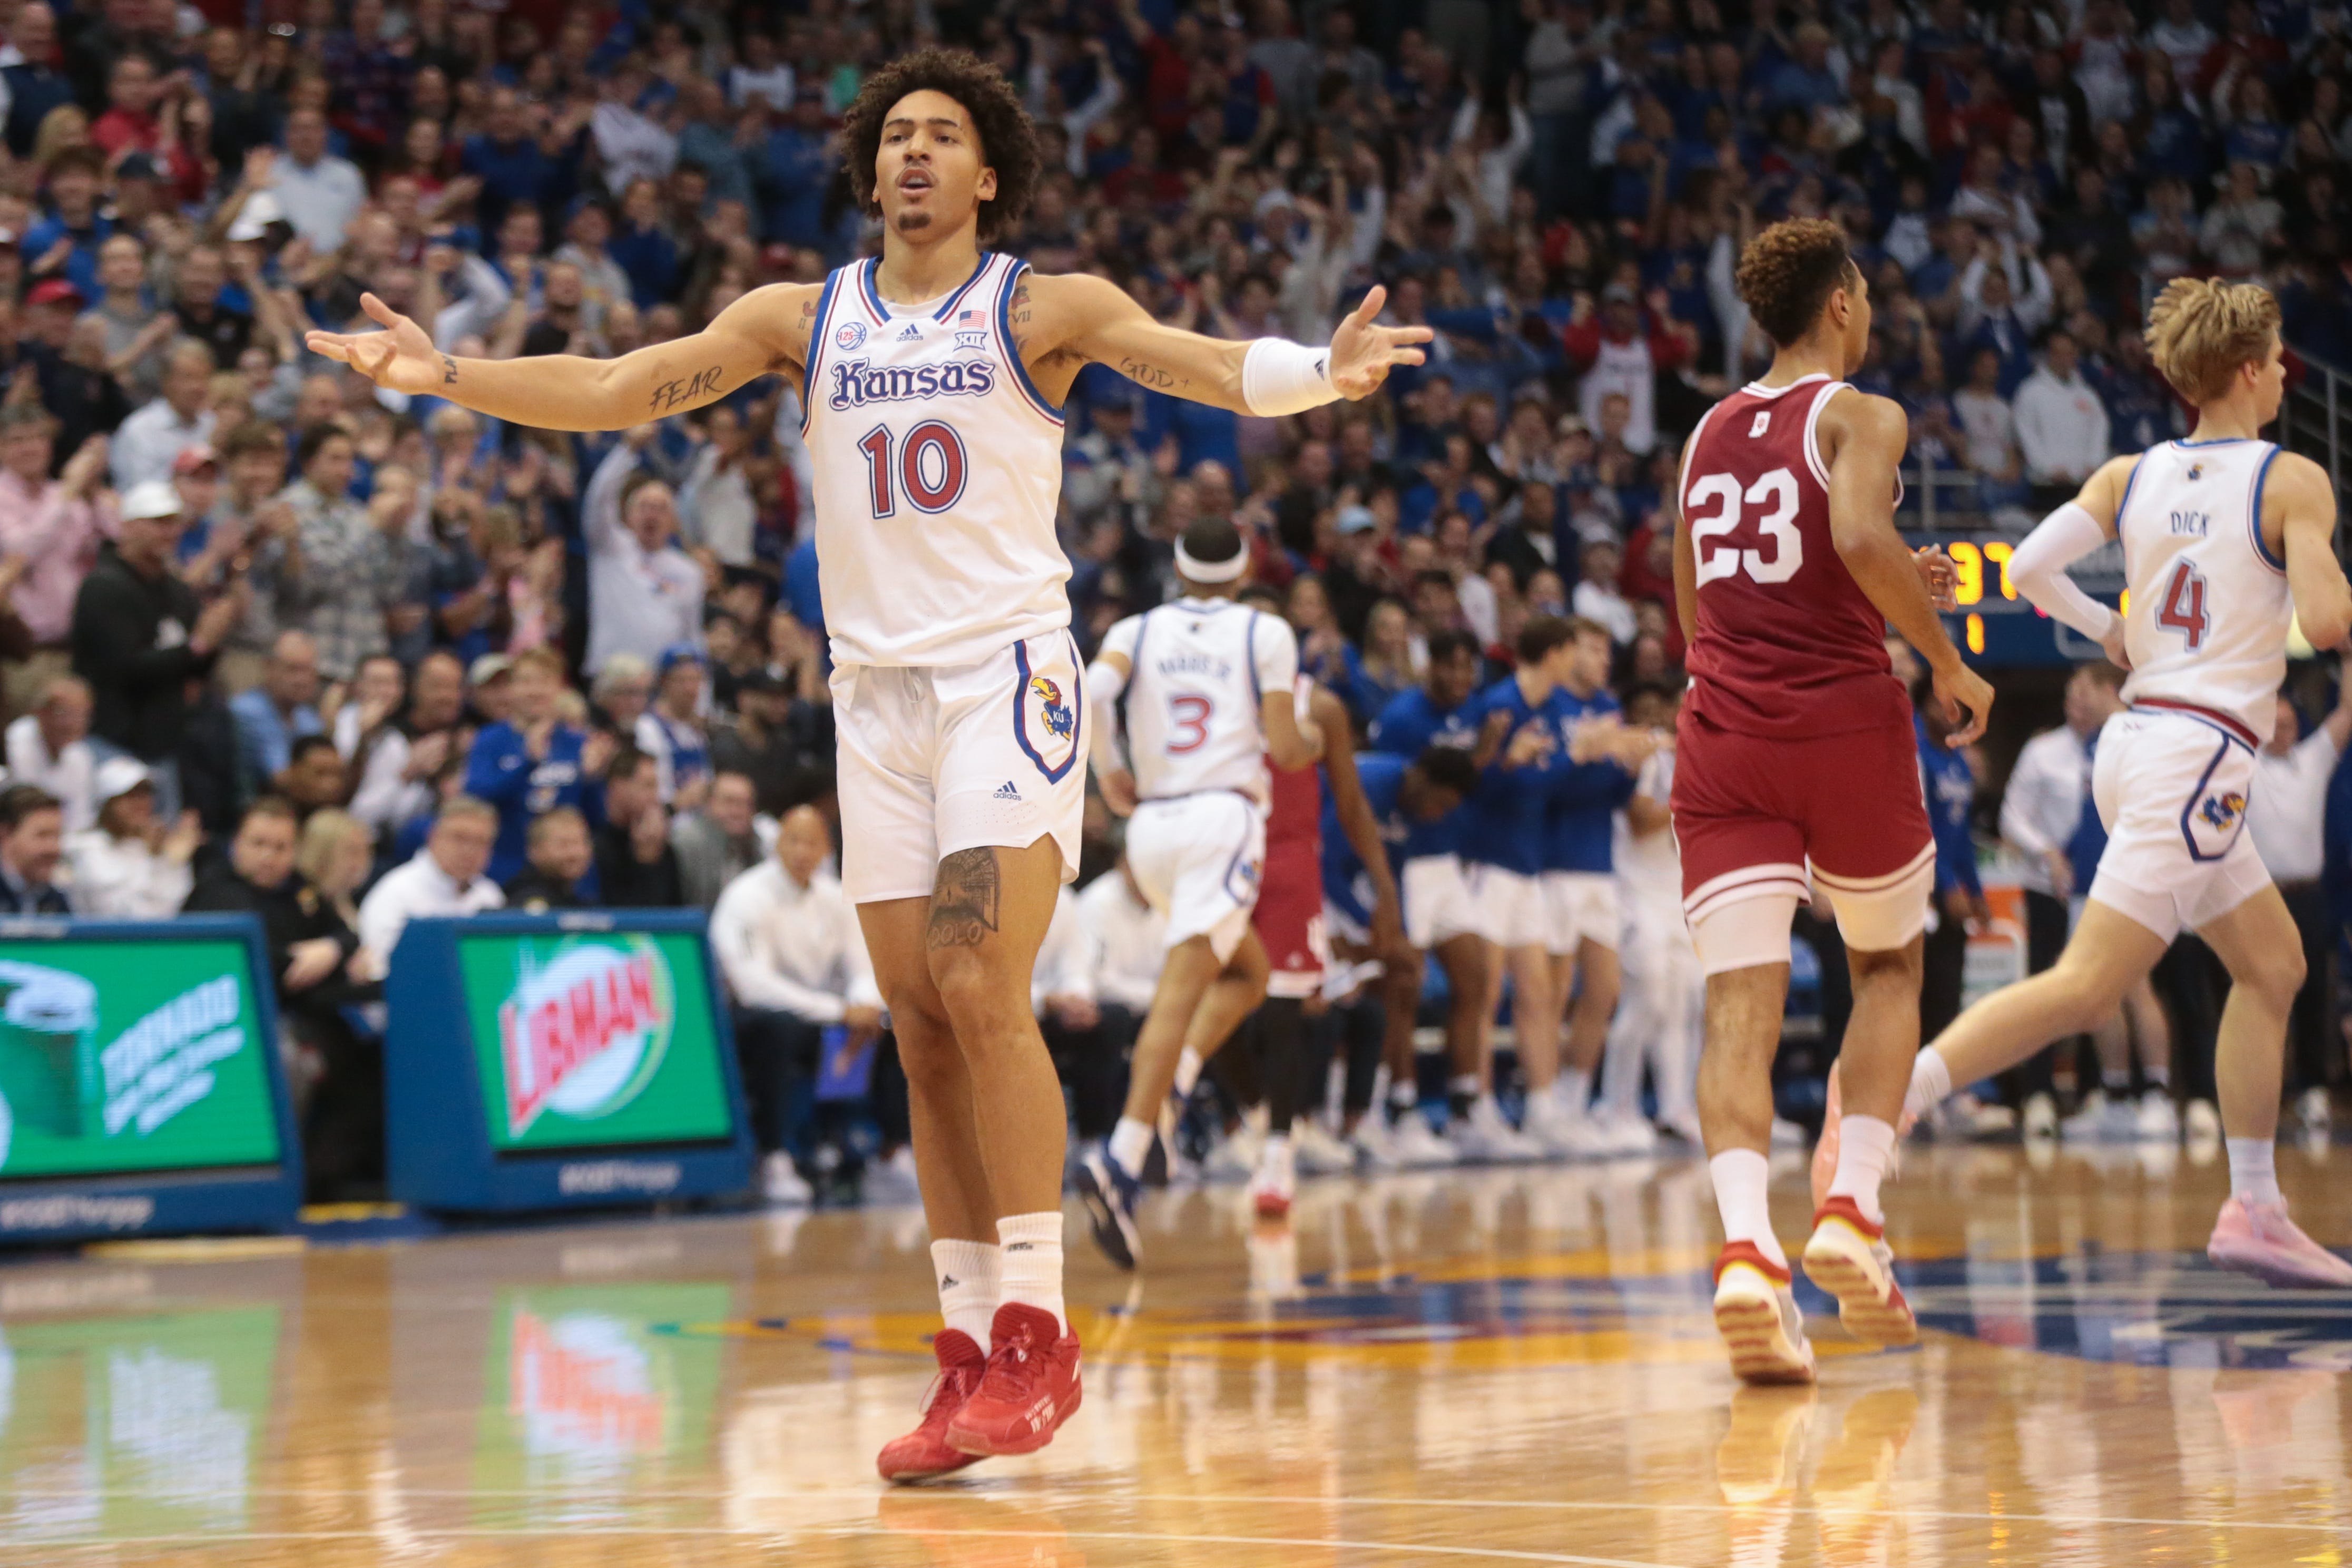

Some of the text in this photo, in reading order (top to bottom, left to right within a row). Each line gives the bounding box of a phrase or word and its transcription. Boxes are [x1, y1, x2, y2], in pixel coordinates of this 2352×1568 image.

[838, 331, 854, 341] 125
[896, 334, 923, 342] adidas
[954, 331, 988, 351] XII
[649, 366, 725, 414] FEAR
[830, 358, 994, 410] Kansas
[1120, 357, 1174, 387] GOD
[858, 419, 968, 520] 10
[1688, 467, 1803, 590] 23
[2170, 511, 2210, 536] DICK
[2155, 555, 2210, 653] 4
[1966, 613, 1985, 655] 1
[1053, 711, 1064, 723] KU
[1165, 692, 1214, 757] 3
[993, 791, 1022, 800] adidas
